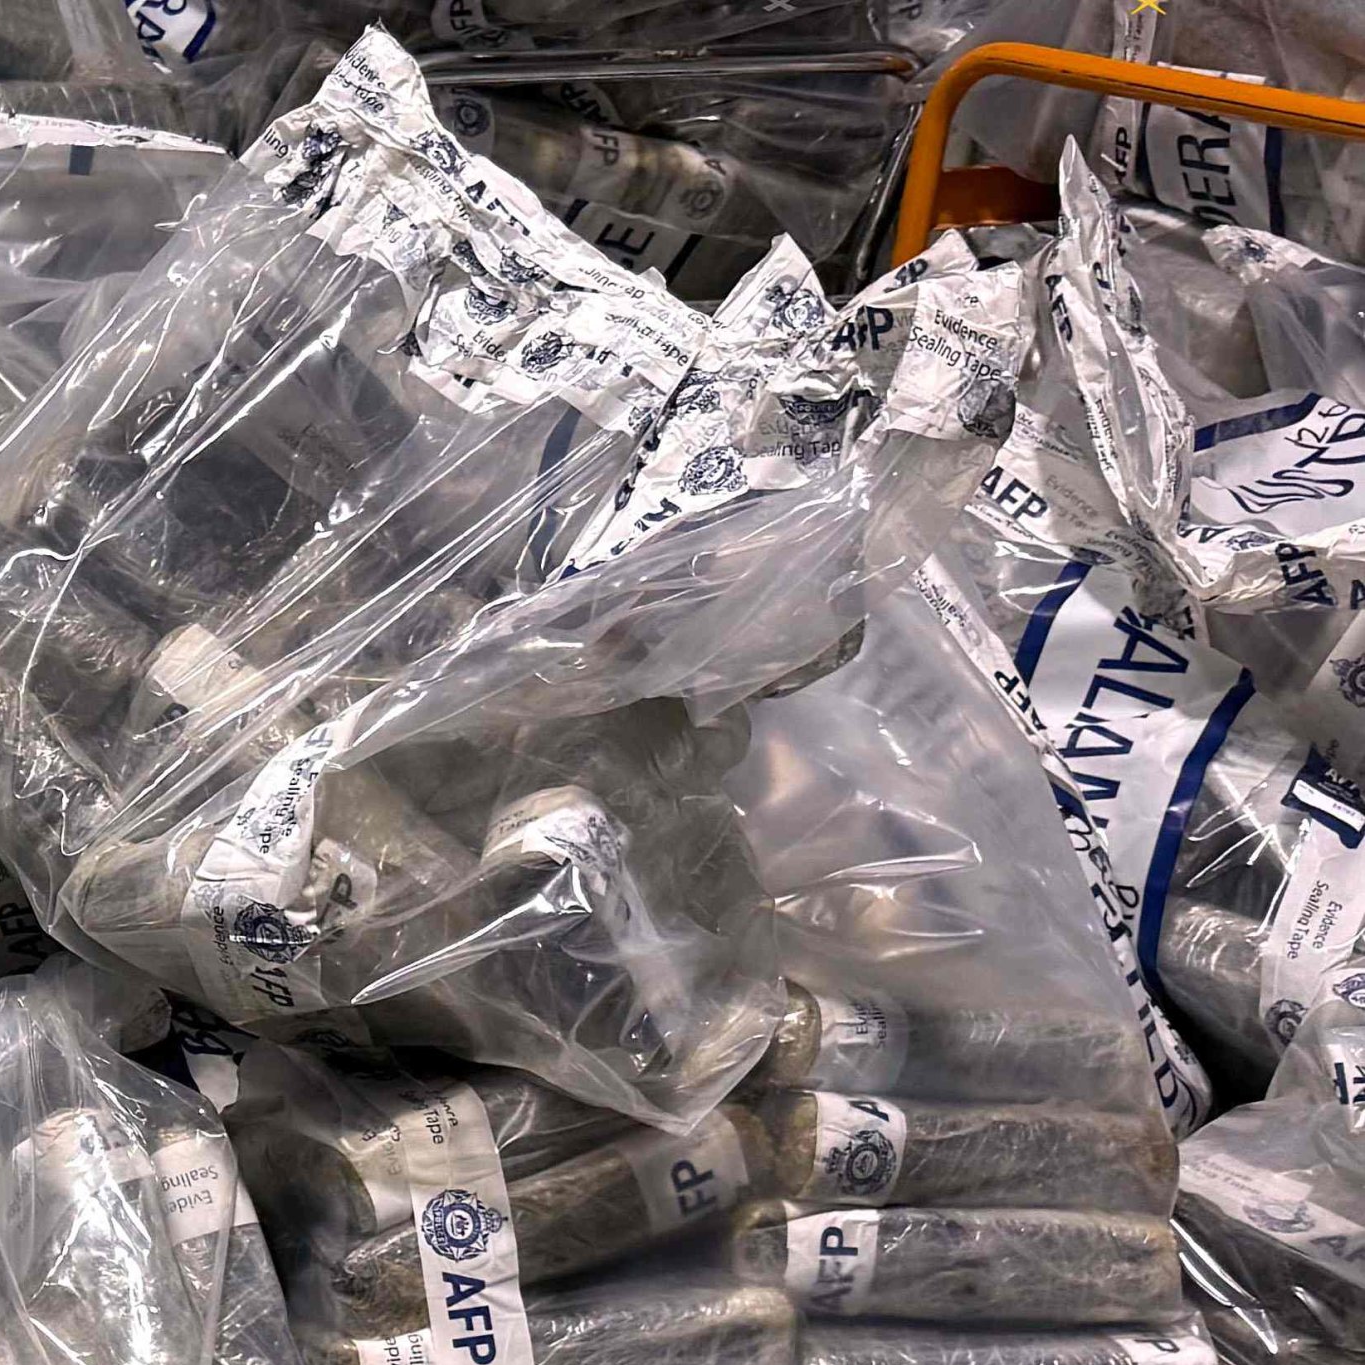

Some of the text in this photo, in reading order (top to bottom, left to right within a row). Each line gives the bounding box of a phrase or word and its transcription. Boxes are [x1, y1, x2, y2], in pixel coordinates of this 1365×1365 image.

[592, 132, 620, 168] FP
[908, 326, 1003, 382] Sealing Tape
[933, 307, 999, 351] Evidence
[981, 467, 1048, 521] AFP
[1274, 542, 1338, 606] AFP
[1287, 878, 1328, 960] Sealing Tape
[671, 1158, 714, 1219] FP
[441, 1270, 496, 1365] AFP
